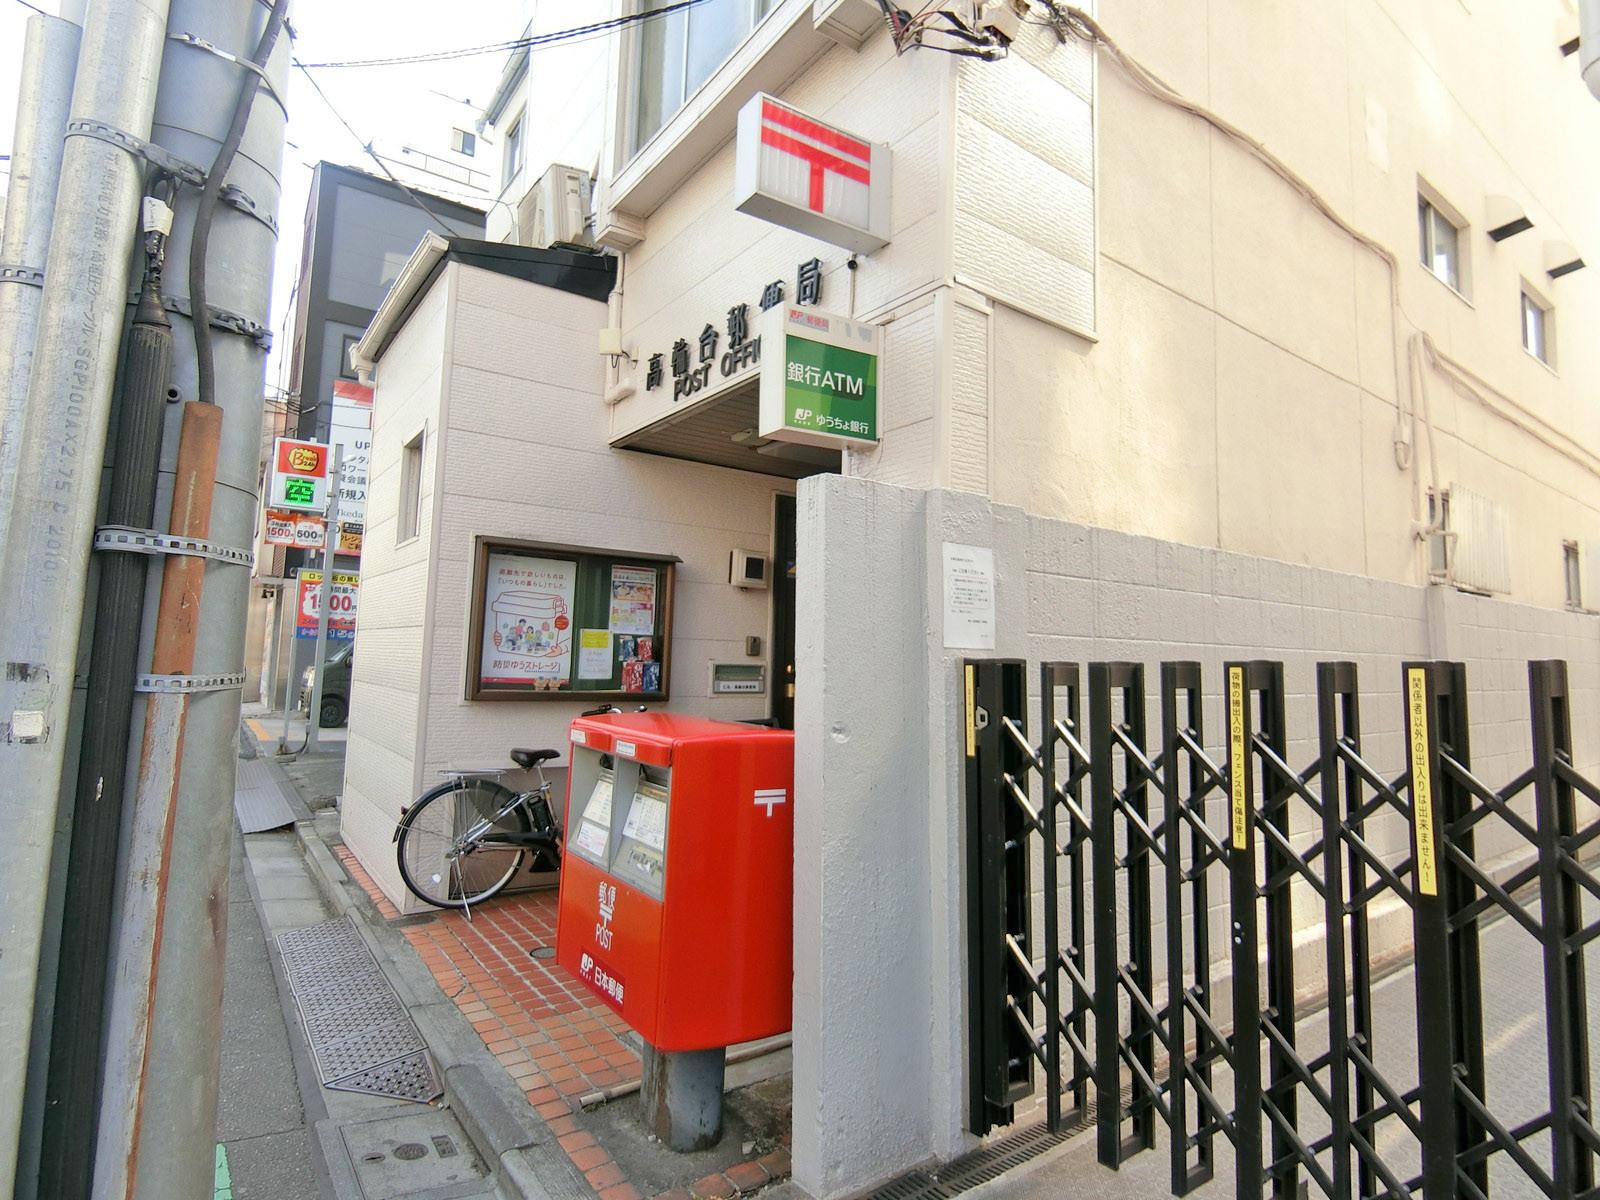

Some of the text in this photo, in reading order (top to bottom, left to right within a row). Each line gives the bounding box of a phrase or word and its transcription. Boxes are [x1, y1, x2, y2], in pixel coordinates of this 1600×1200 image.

[674, 363, 711, 402] POST
[787, 361, 863, 396] 銀行ATM
[816, 414, 869, 434] ゆうちょ銀行
[284, 479, 315, 506] 空
[493, 659, 559, 671] 防災ゆうストレージ
[598, 881, 616, 911] 郵便
[595, 923, 613, 951] POST
[594, 966, 625, 1004] 日本郵便
